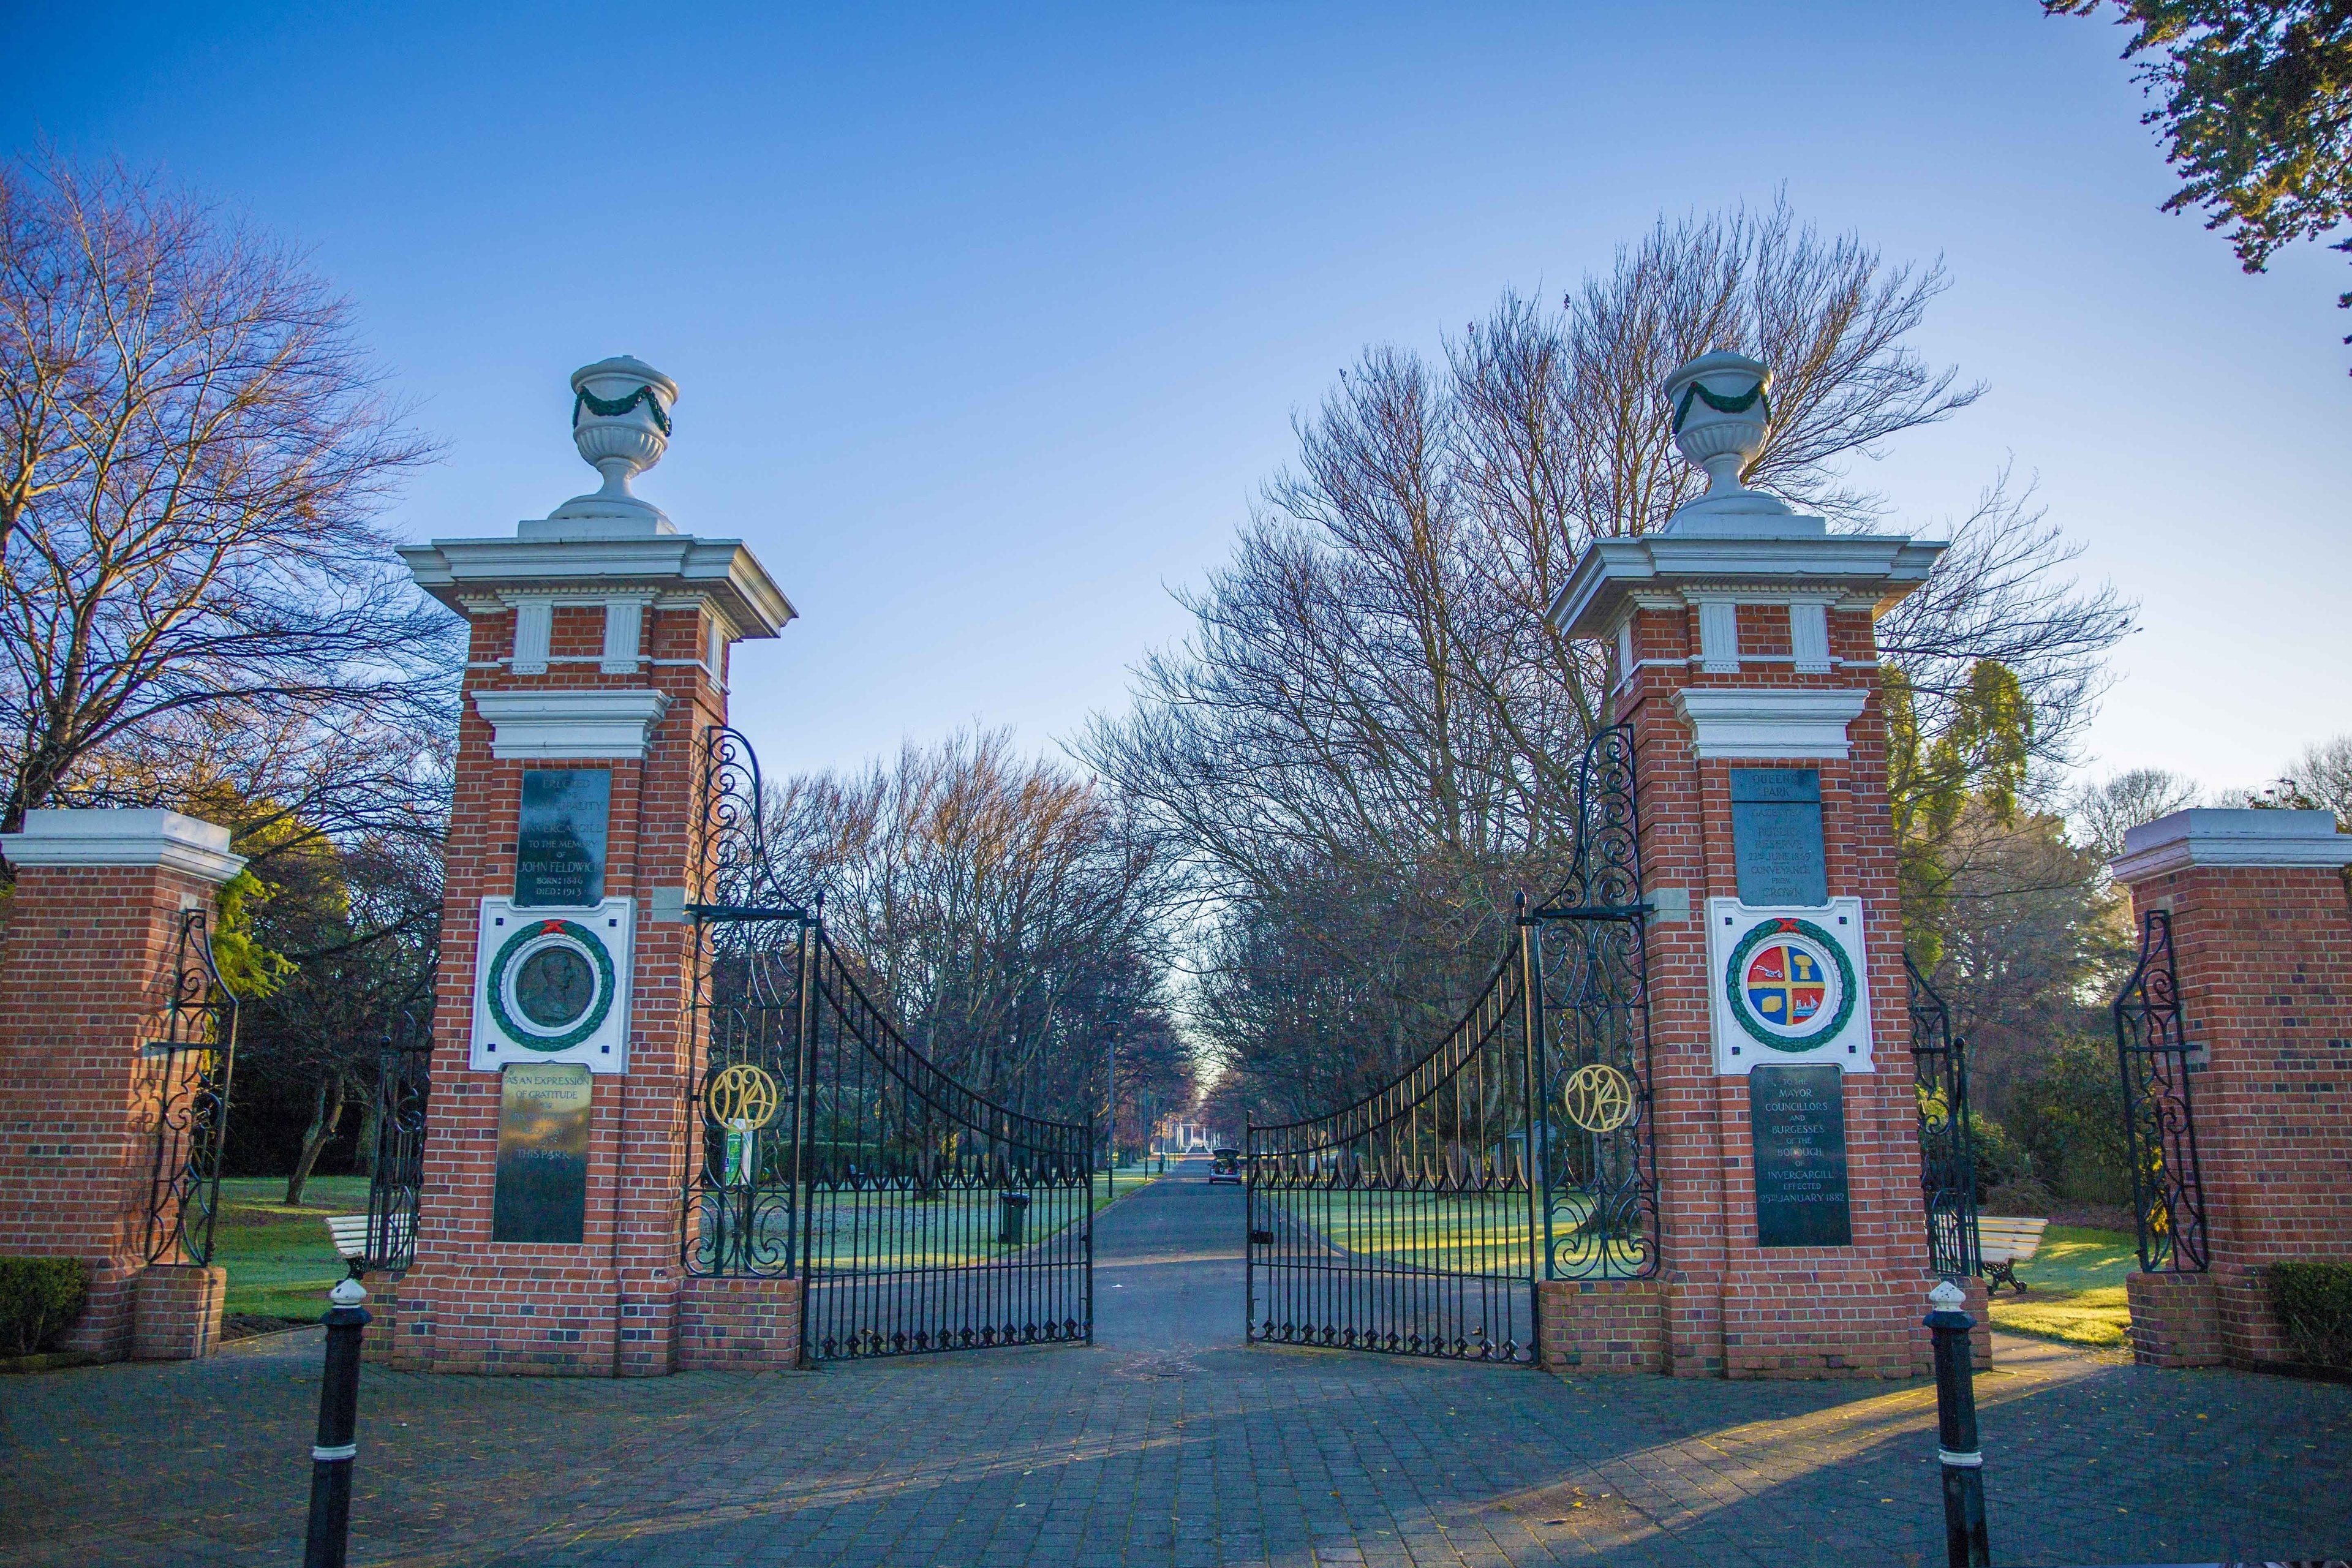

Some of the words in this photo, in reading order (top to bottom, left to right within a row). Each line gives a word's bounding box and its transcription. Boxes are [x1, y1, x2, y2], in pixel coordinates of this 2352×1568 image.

[1763, 787, 1790, 797] PARK
[1755, 840, 1803, 849] RESERVE
[1765, 852, 1790, 861] JUNE
[518, 861, 548, 873] JOHN
[1751, 865, 1811, 875] CONVEYANCE
[562, 888, 582, 897] 1913
[1762, 888, 1802, 897] CROWN
[529, 1090, 578, 1099] GRATITUDE
[1778, 1088, 1813, 1098] MAYOR
[1765, 1102, 1828, 1112] COUNCILLORS
[1772, 1125, 1825, 1134] BURGESSES
[518, 1149, 540, 1158] THIS
[541, 1149, 570, 1159] PARK
[1777, 1147, 1822, 1156] BOROUGH
[1768, 1170, 1834, 1180] INVERCARGILL
[1777, 1193, 1825, 1203] JANUARY
[1825, 1193, 1845, 1202] 1882
